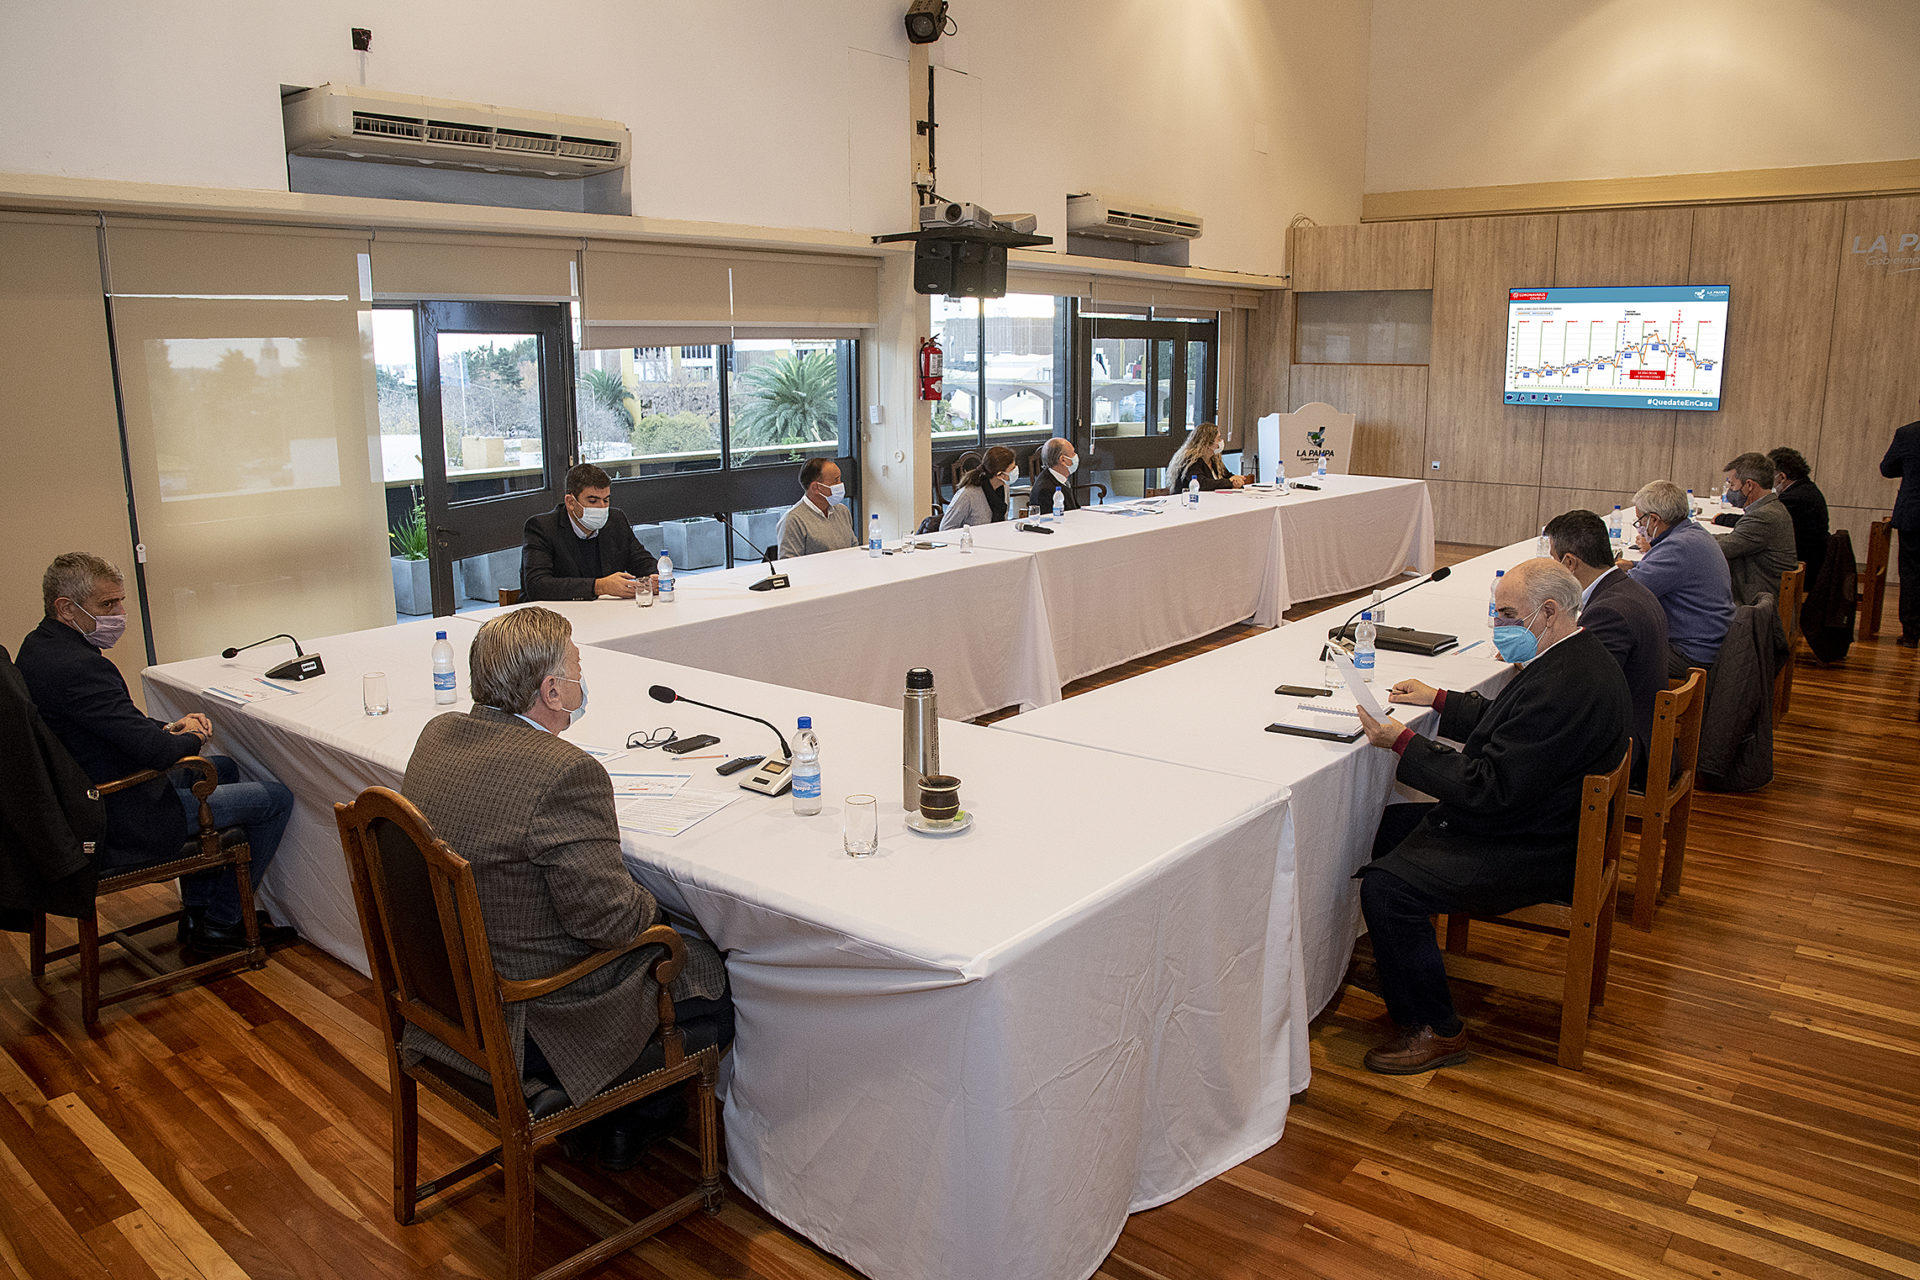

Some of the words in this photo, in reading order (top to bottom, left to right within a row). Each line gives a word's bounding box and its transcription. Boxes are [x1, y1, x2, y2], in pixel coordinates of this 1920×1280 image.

[1852, 235, 1888, 253] LA
[1647, 398, 1713, 407] #QuedateEnCasa
[1296, 449, 1307, 457] LA
[1308, 449, 1335, 457] PAMPA
